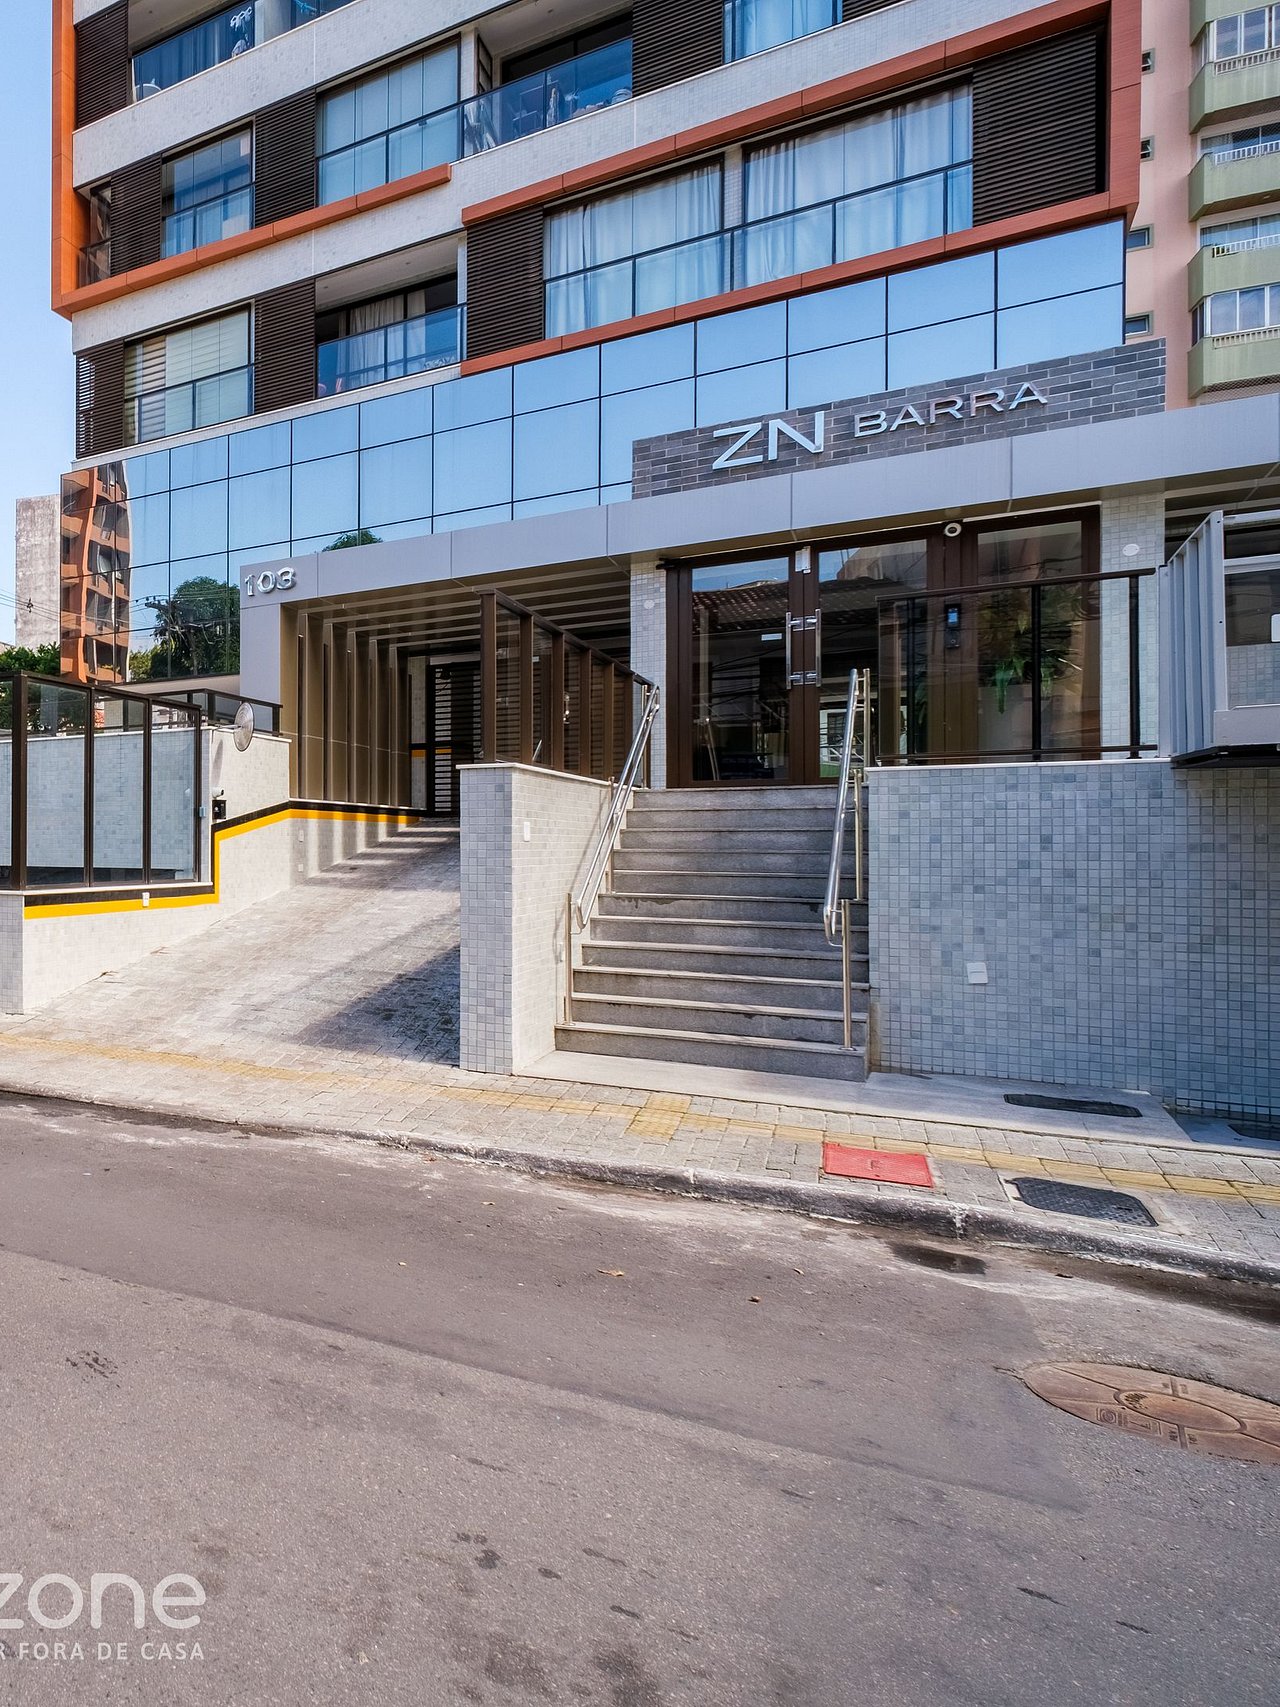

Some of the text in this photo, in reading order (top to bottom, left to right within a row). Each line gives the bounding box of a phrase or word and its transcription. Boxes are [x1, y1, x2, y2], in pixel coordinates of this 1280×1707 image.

[712, 382, 1048, 470] ZN BARRA
[244, 566, 297, 597] 103
